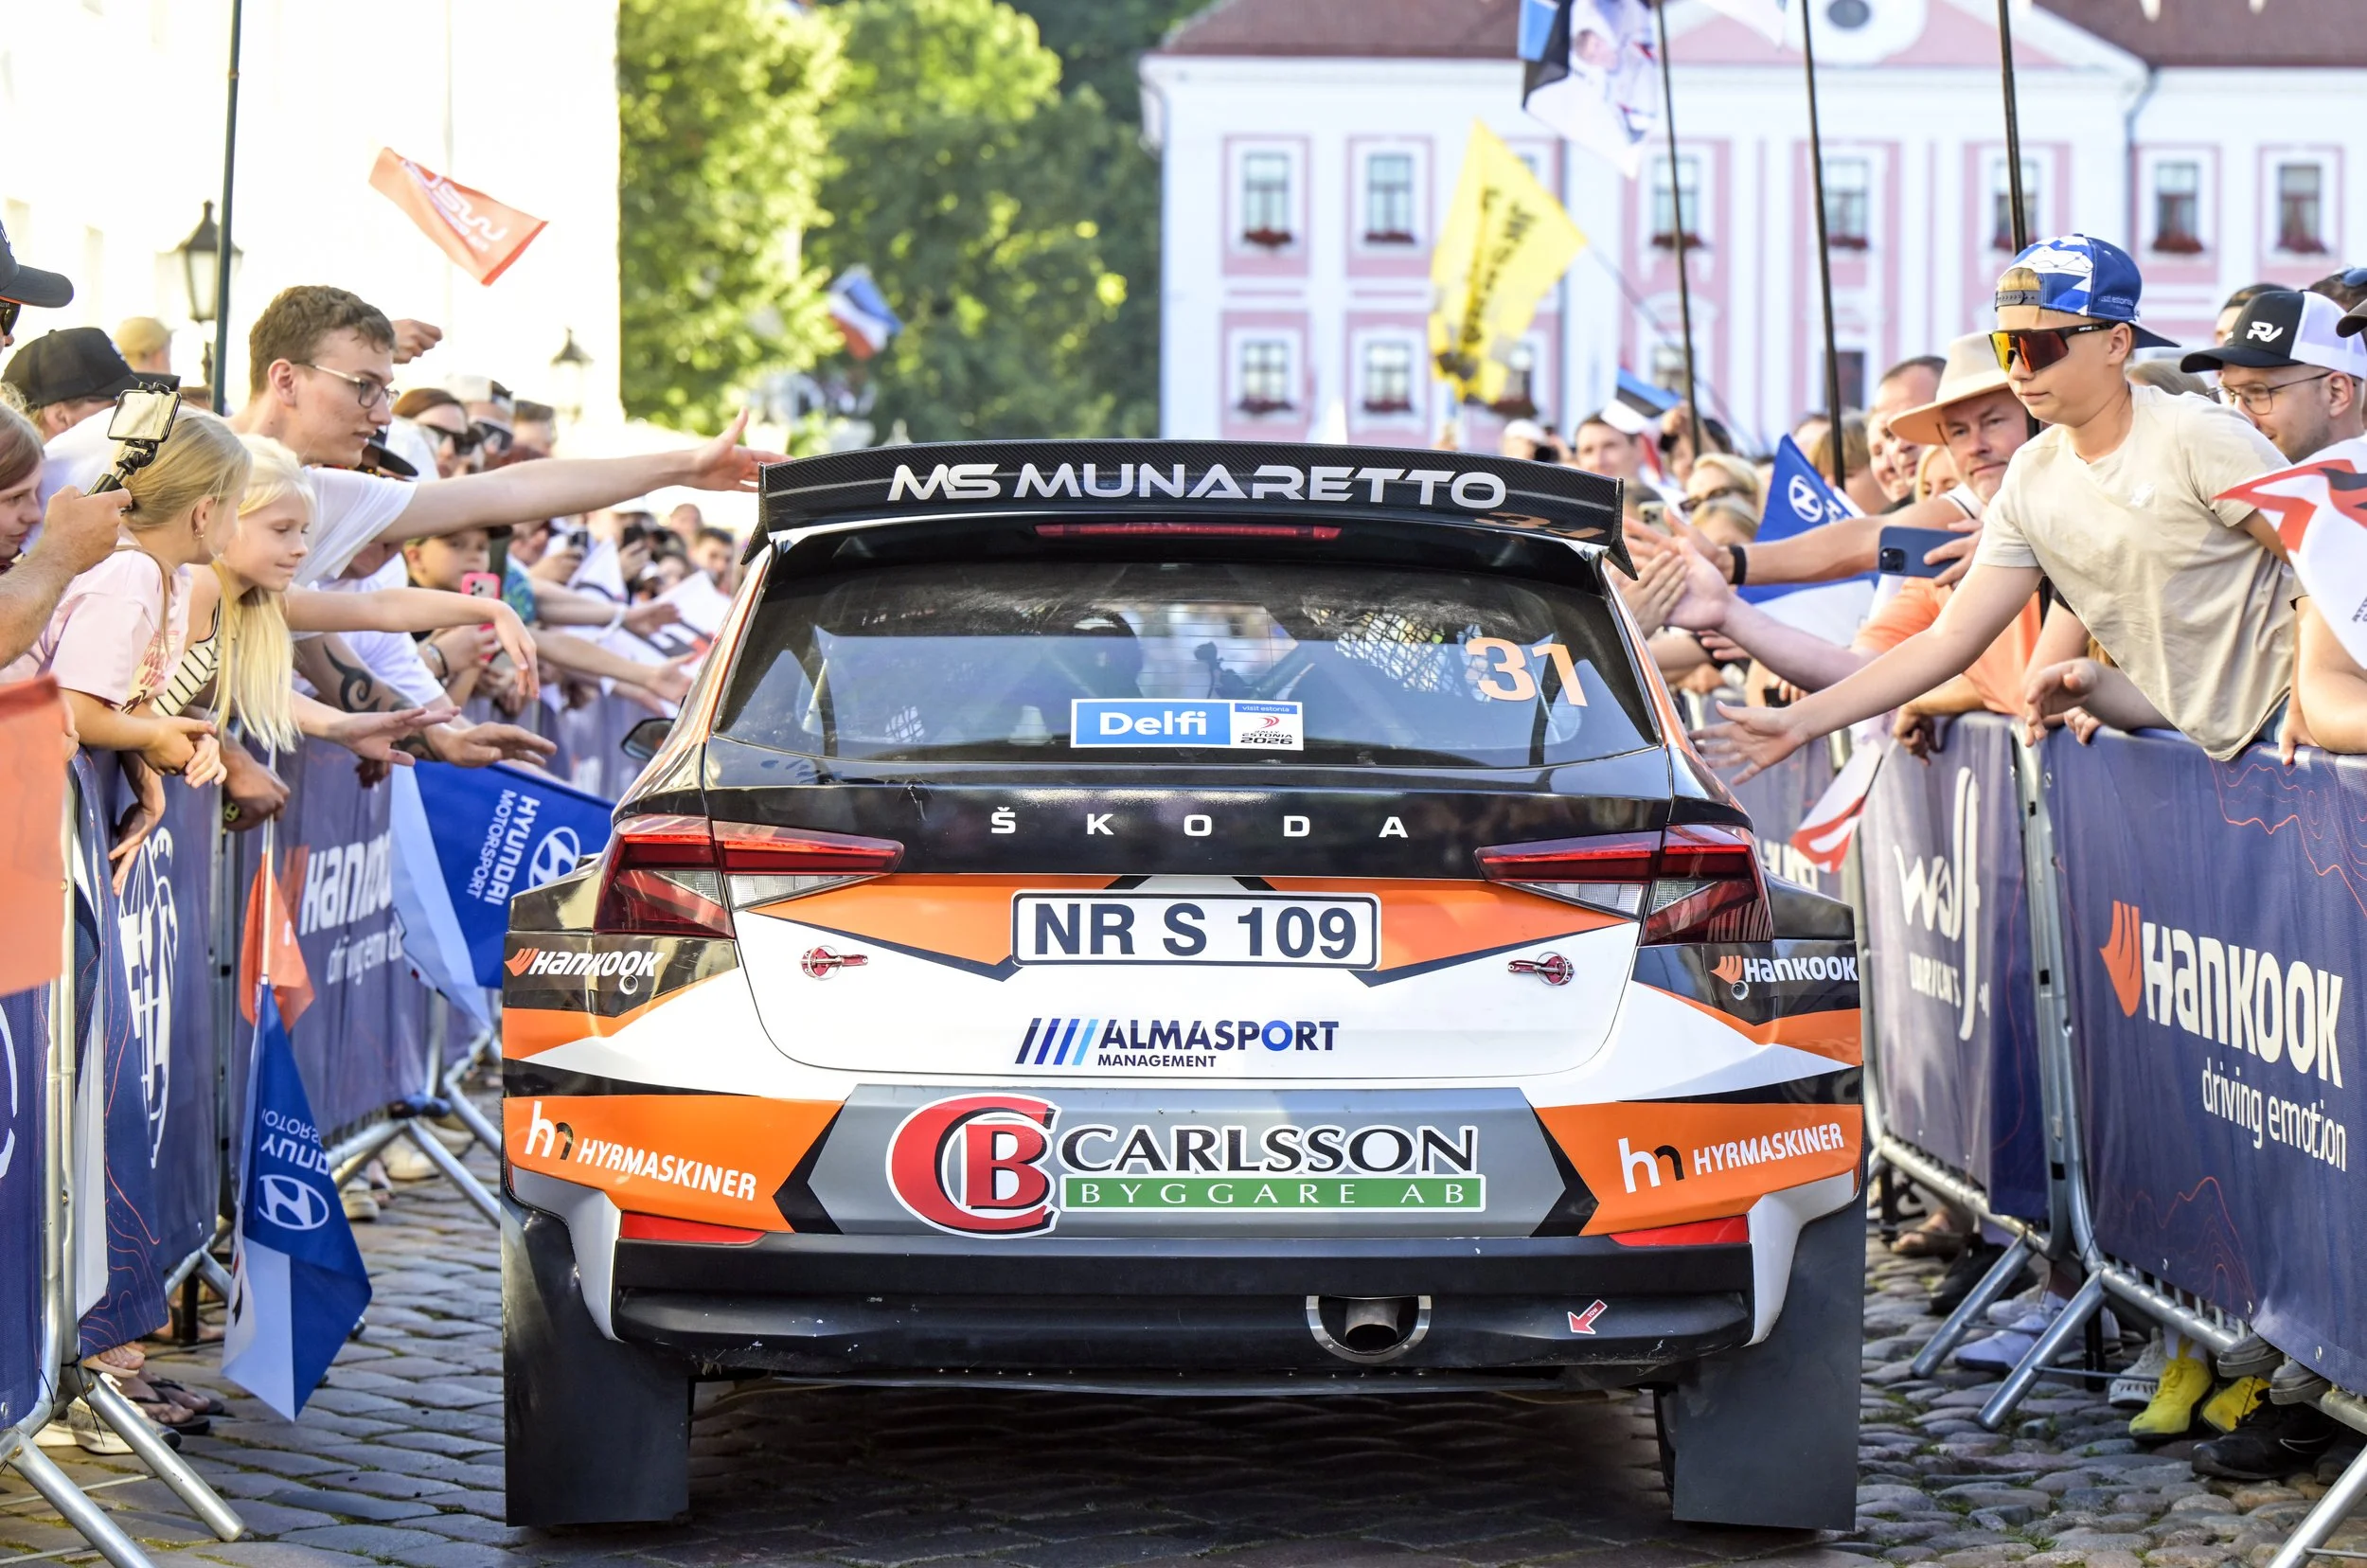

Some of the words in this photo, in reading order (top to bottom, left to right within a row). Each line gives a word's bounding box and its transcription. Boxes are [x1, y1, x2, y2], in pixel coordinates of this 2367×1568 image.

[887, 463, 1001, 501] MS
[1013, 462, 1506, 508] MUNARETTO
[1466, 637, 1588, 706] 31
[1099, 710, 1207, 736] Delfi
[1240, 737, 1293, 745] 2026
[466, 789, 518, 900] MOTORSPORT
[484, 794, 541, 906] HYUNDAI
[1035, 902, 1135, 955] NR
[1163, 902, 1207, 956] S
[1237, 906, 1357, 959] 109
[1098, 1019, 1340, 1052] ALMASPORT
[1097, 1055, 1217, 1067] MANAGEMENT
[2201, 1057, 2263, 1149] driving
[2268, 1095, 2347, 1172] emotion
[576, 1137, 756, 1202] HYRMASKINER
[1061, 1127, 1473, 1172] CARLSSON
[1693, 1123, 1844, 1176] HYRMASKINER
[1081, 1183, 1356, 1204] BYGGARE
[1400, 1183, 1465, 1204] AB
